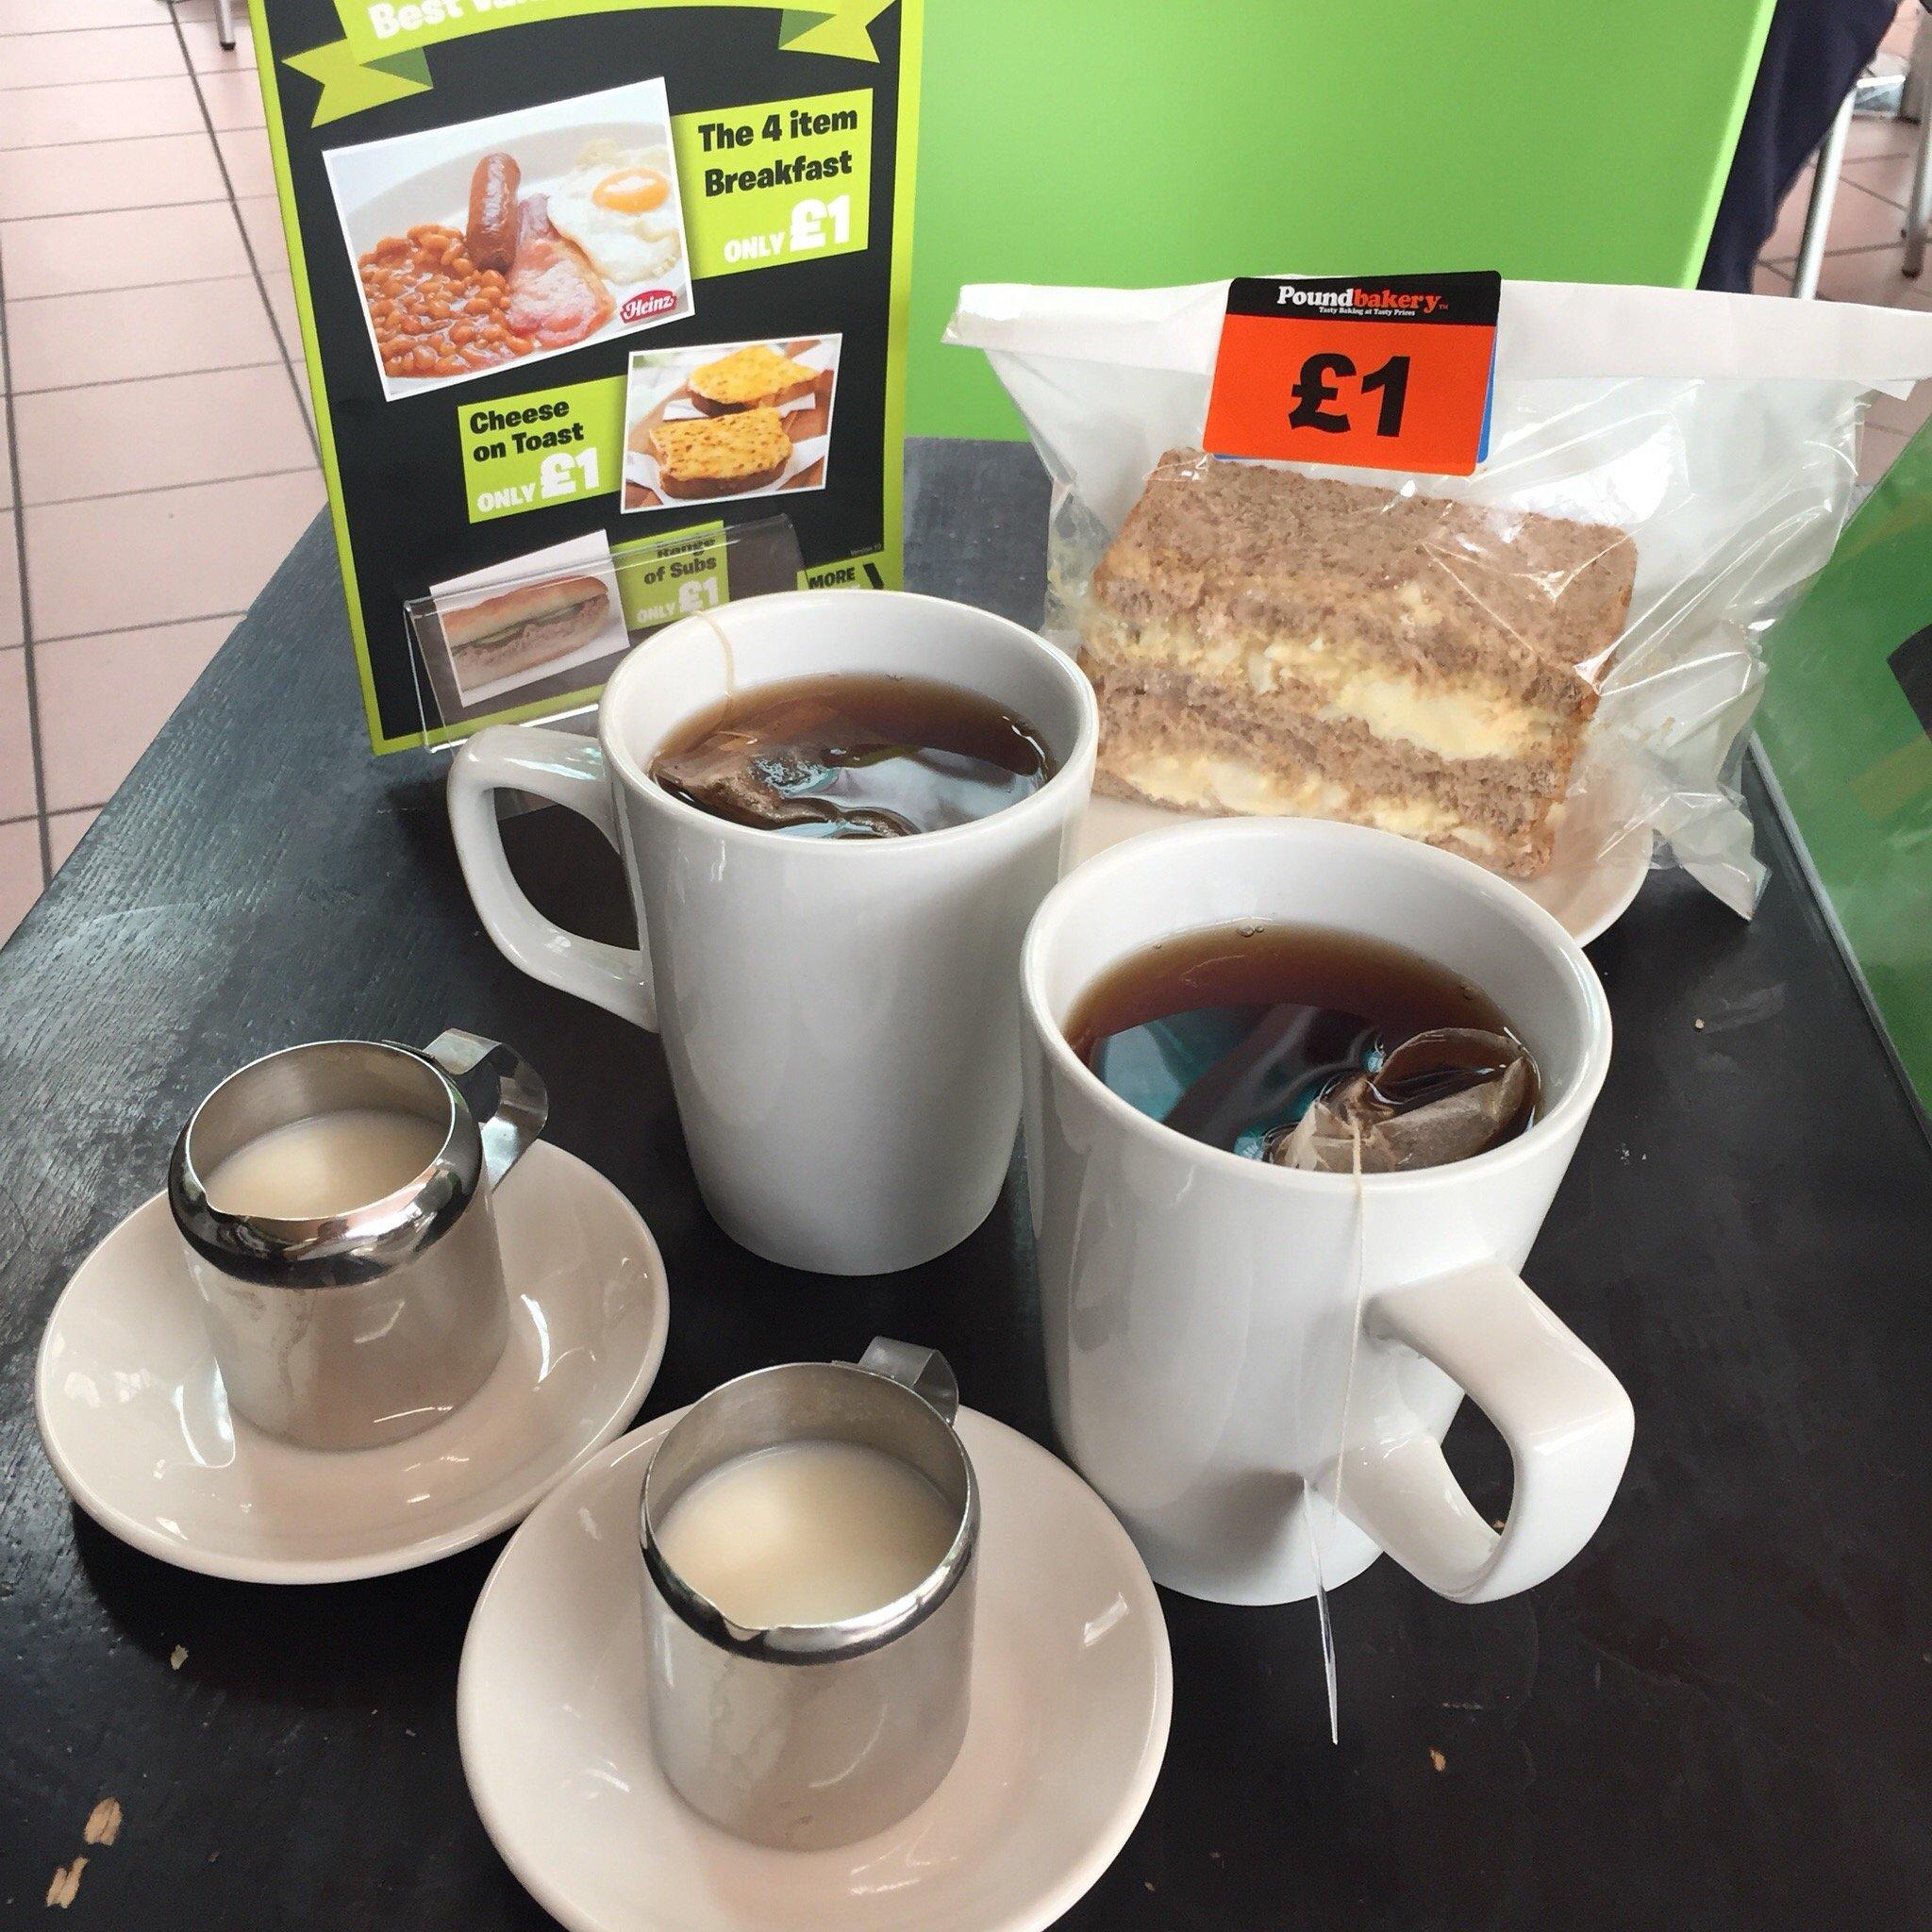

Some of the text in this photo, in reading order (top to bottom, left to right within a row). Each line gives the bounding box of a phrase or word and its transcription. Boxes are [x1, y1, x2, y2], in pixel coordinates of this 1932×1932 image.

[698, 109, 858, 152] The 4 item
[705, 150, 852, 197] Breakfast
[724, 194, 851, 262] ONLY £1
[623, 295, 675, 320] Heinz
[1277, 285, 1441, 313] Poundbakery
[1339, 308, 1363, 316] Baking
[1289, 353, 1410, 438] £1
[470, 401, 570, 434] Cheese
[473, 423, 585, 462] on Toast
[477, 447, 600, 512] ONLY £1
[644, 557, 717, 585] of Subs
[808, 567, 856, 590] MORE
[637, 577, 719, 623] ONLY £1
